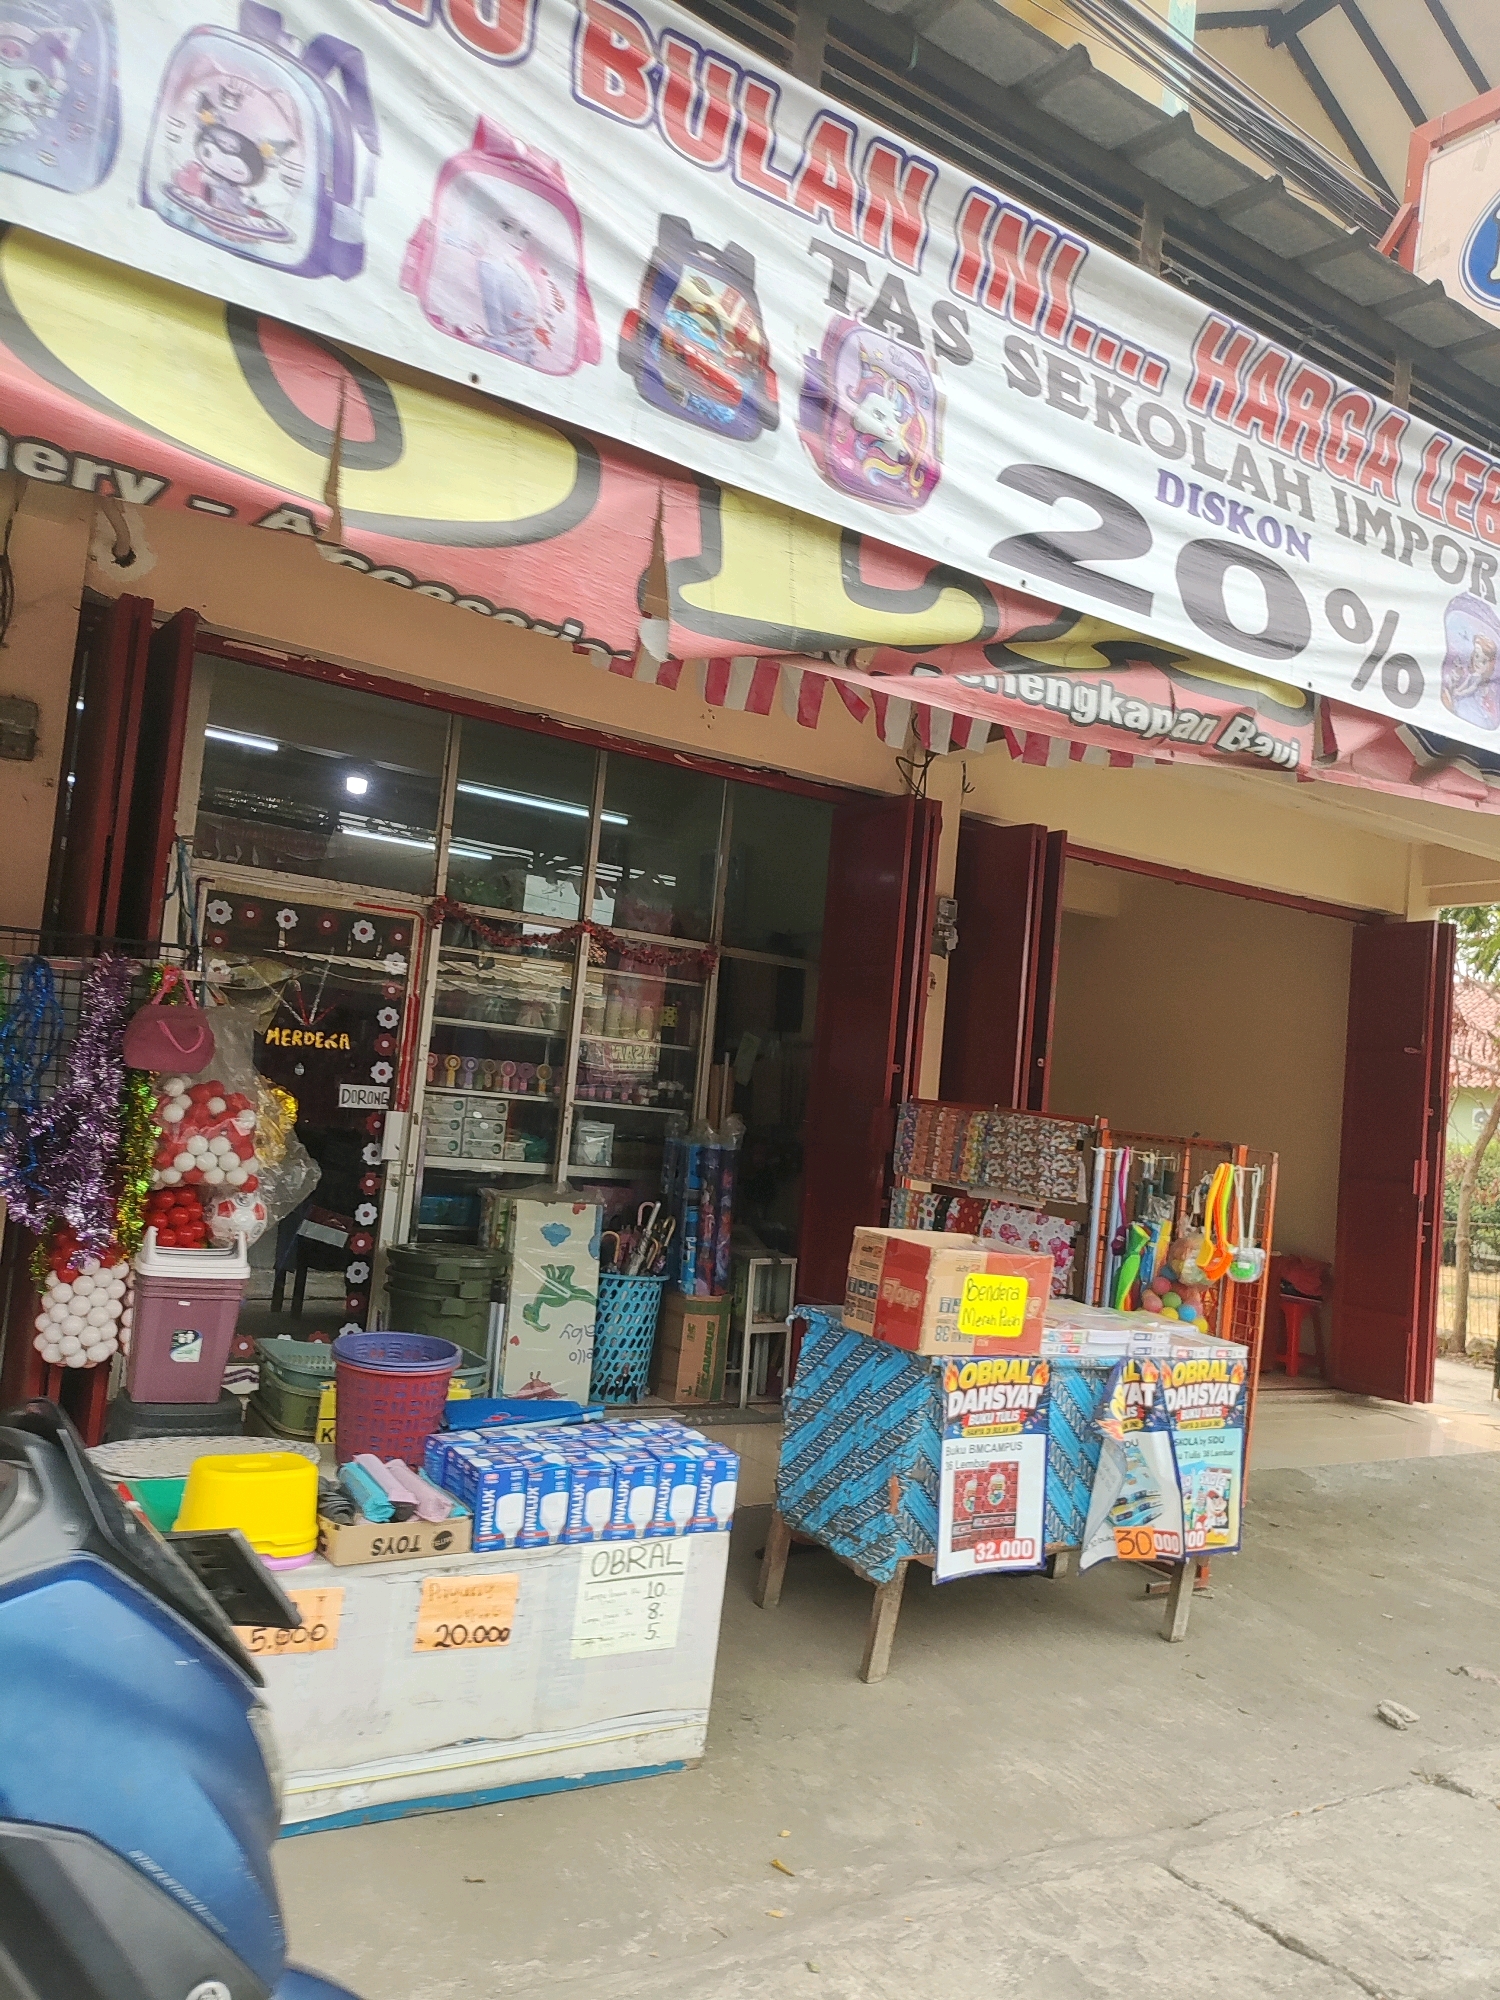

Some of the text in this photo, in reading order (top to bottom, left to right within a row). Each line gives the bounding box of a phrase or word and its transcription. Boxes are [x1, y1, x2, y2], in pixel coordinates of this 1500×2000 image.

[572, 0, 940, 275] BULAN
[1184, 311, 1410, 507] HARGA
[807, 237, 974, 366] TAS
[1002, 335, 1316, 522] SEKOLAH
[1156, 467, 1312, 562] DISKON
[265, 1027, 350, 1050] MERDEKA
[966, 1278, 1020, 1302] Bendera
[958, 1358, 1031, 1391] OBRAL
[1171, 1359, 1229, 1387] OBRAL
[947, 1384, 1043, 1419] DAHSYAT
[1164, 1383, 1241, 1413] DAHSYAT
[480, 1488, 496, 1534] INALUX
[525, 1486, 540, 1531] INALUX
[570, 1482, 585, 1528] INALUX
[613, 1478, 630, 1524] INALUX
[656, 1477, 672, 1521] INALUX
[697, 1474, 713, 1517] INALUX
[371, 1534, 422, 1557] TOYS
[975, 1539, 1033, 1561] 32.000
[1116, 1529, 1152, 1556] 30
[591, 1543, 683, 1577] OBRAL
[434, 1623, 511, 1648] 20.000
